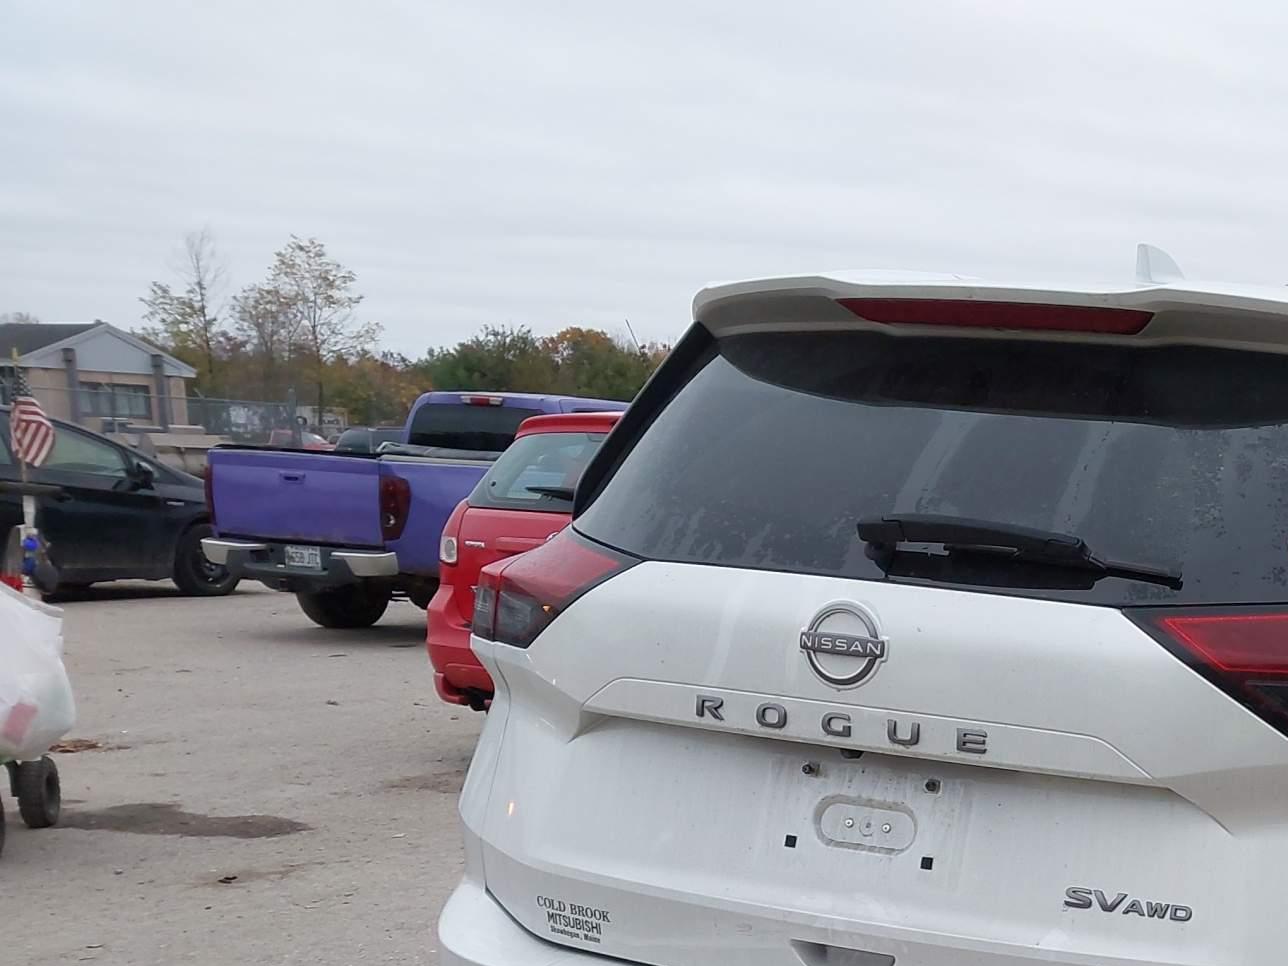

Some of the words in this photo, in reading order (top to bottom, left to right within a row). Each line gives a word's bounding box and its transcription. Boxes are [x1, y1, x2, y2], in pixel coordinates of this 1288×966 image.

[801, 634, 881, 656] NISSAN
[695, 694, 989, 755] ROGUE
[536, 895, 566, 912] COLD
[569, 903, 611, 923] BROOK
[546, 910, 602, 935] MITSUBISHI
